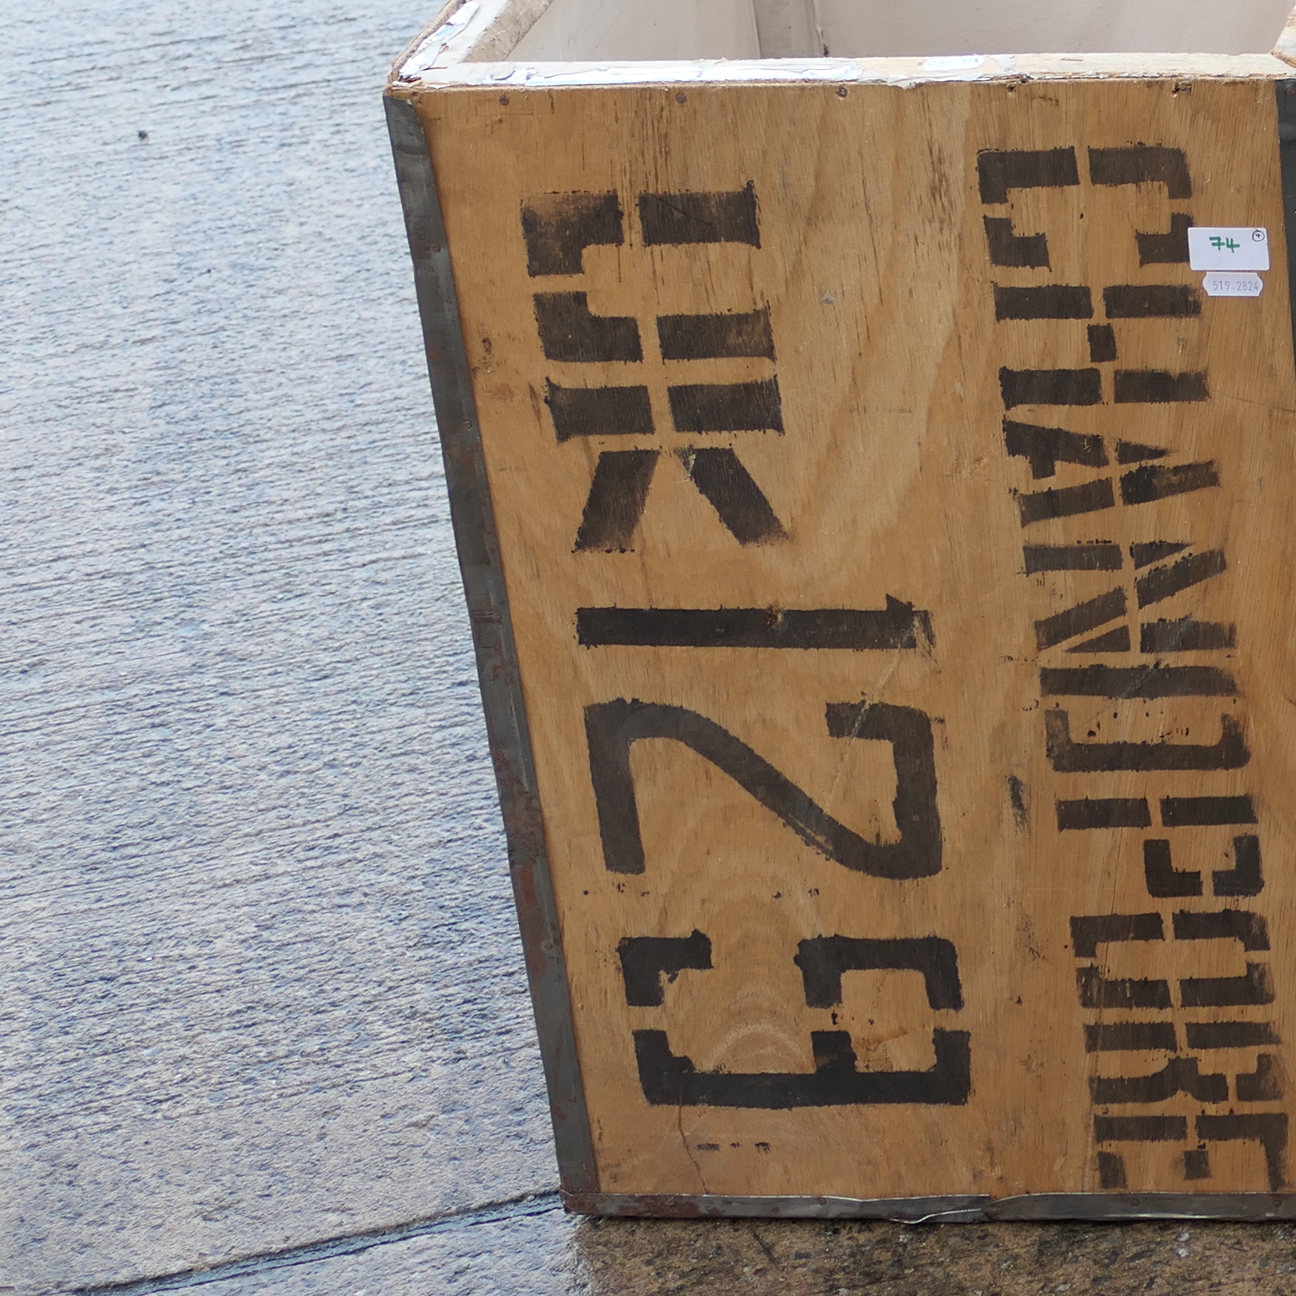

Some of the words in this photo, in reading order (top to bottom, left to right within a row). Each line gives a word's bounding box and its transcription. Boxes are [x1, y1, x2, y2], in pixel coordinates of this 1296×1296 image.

[1208, 236, 1241, 254] 74
[1212, 279, 1260, 292] 519.2824
[519, 180, 793, 554] UK
[573, 593, 971, 1108] 129
